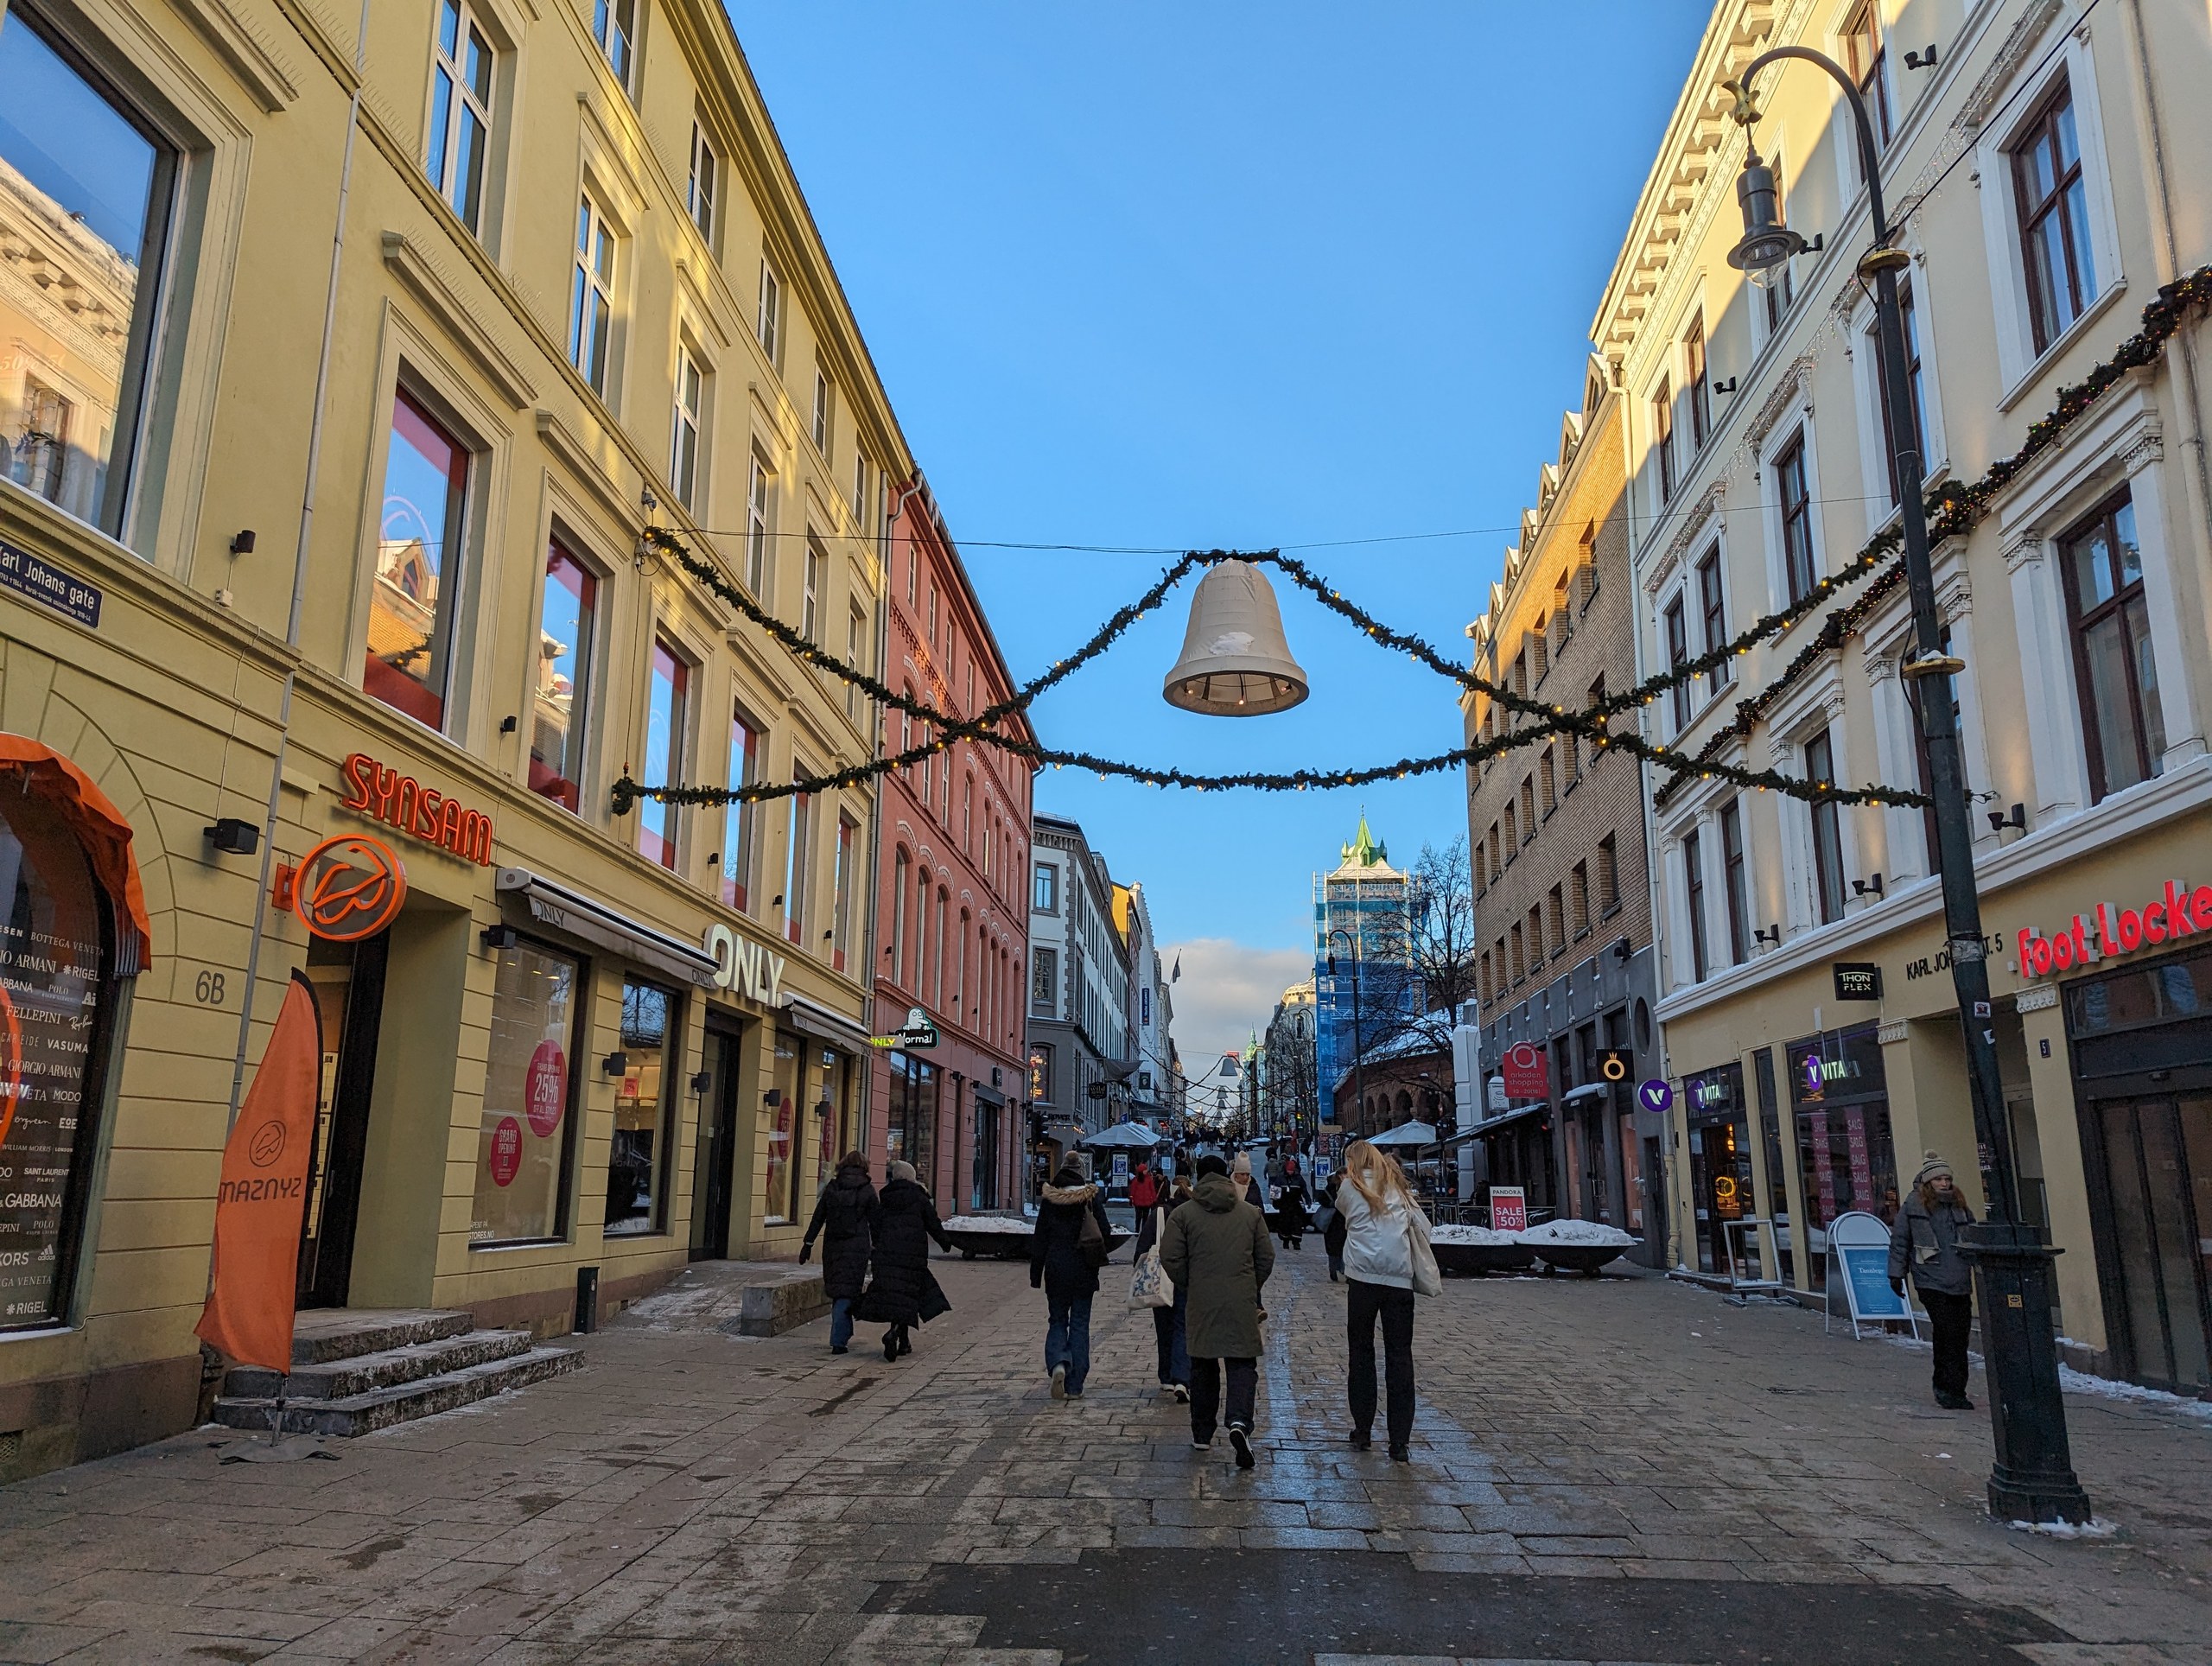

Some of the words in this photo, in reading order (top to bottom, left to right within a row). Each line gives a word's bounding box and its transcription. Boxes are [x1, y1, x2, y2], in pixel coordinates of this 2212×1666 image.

[24, 561, 65, 595] Johans
[69, 588, 94, 609] gate
[340, 753, 493, 867] SYNSAM
[30, 932, 70, 949] BOTTEGA
[73, 941, 104, 957] VENETA
[2018, 914, 2096, 978] Foot
[15, 953, 56, 974] ARMANI
[1906, 957, 1932, 981] KARL
[1996, 933, 2003, 951] 5
[704, 924, 785, 1008] ONLY
[72, 966, 100, 982] RIGEL
[1840, 972, 1873, 982] THON
[48, 984, 68, 995] POLO
[195, 970, 225, 1004] 6B
[6, 1005, 61, 1025] FELLEPINI
[21, 1034, 40, 1047] EIDE
[48, 1039, 88, 1053] VASUMA
[8, 1059, 46, 1074] GIORGIO
[48, 1065, 81, 1078] ARMANI
[1821, 1060, 1847, 1080] VITA
[534, 1072, 559, 1103] 25%
[1705, 1084, 1720, 1100] VITA
[53, 1091, 82, 1103] MODO
[1847, 1118, 1862, 1130] SALG
[499, 1129, 518, 1143] GRAND
[1849, 1136, 1864, 1148] SALG
[498, 1143, 516, 1154] OPENING
[1852, 1154, 1866, 1165] SALG
[1853, 1172, 1867, 1183] SALG
[5, 1192, 62, 1208] GABBANA
[1855, 1190, 1869, 1200] SALG
[1496, 1207, 1522, 1216] SALE
[33, 1220, 54, 1230] POLO
[1501, 1216, 1523, 1227] 50%
[1, 1277, 14, 1288] GA
[17, 1275, 52, 1287] VENETA
[16, 1300, 48, 1314] RIGEL
